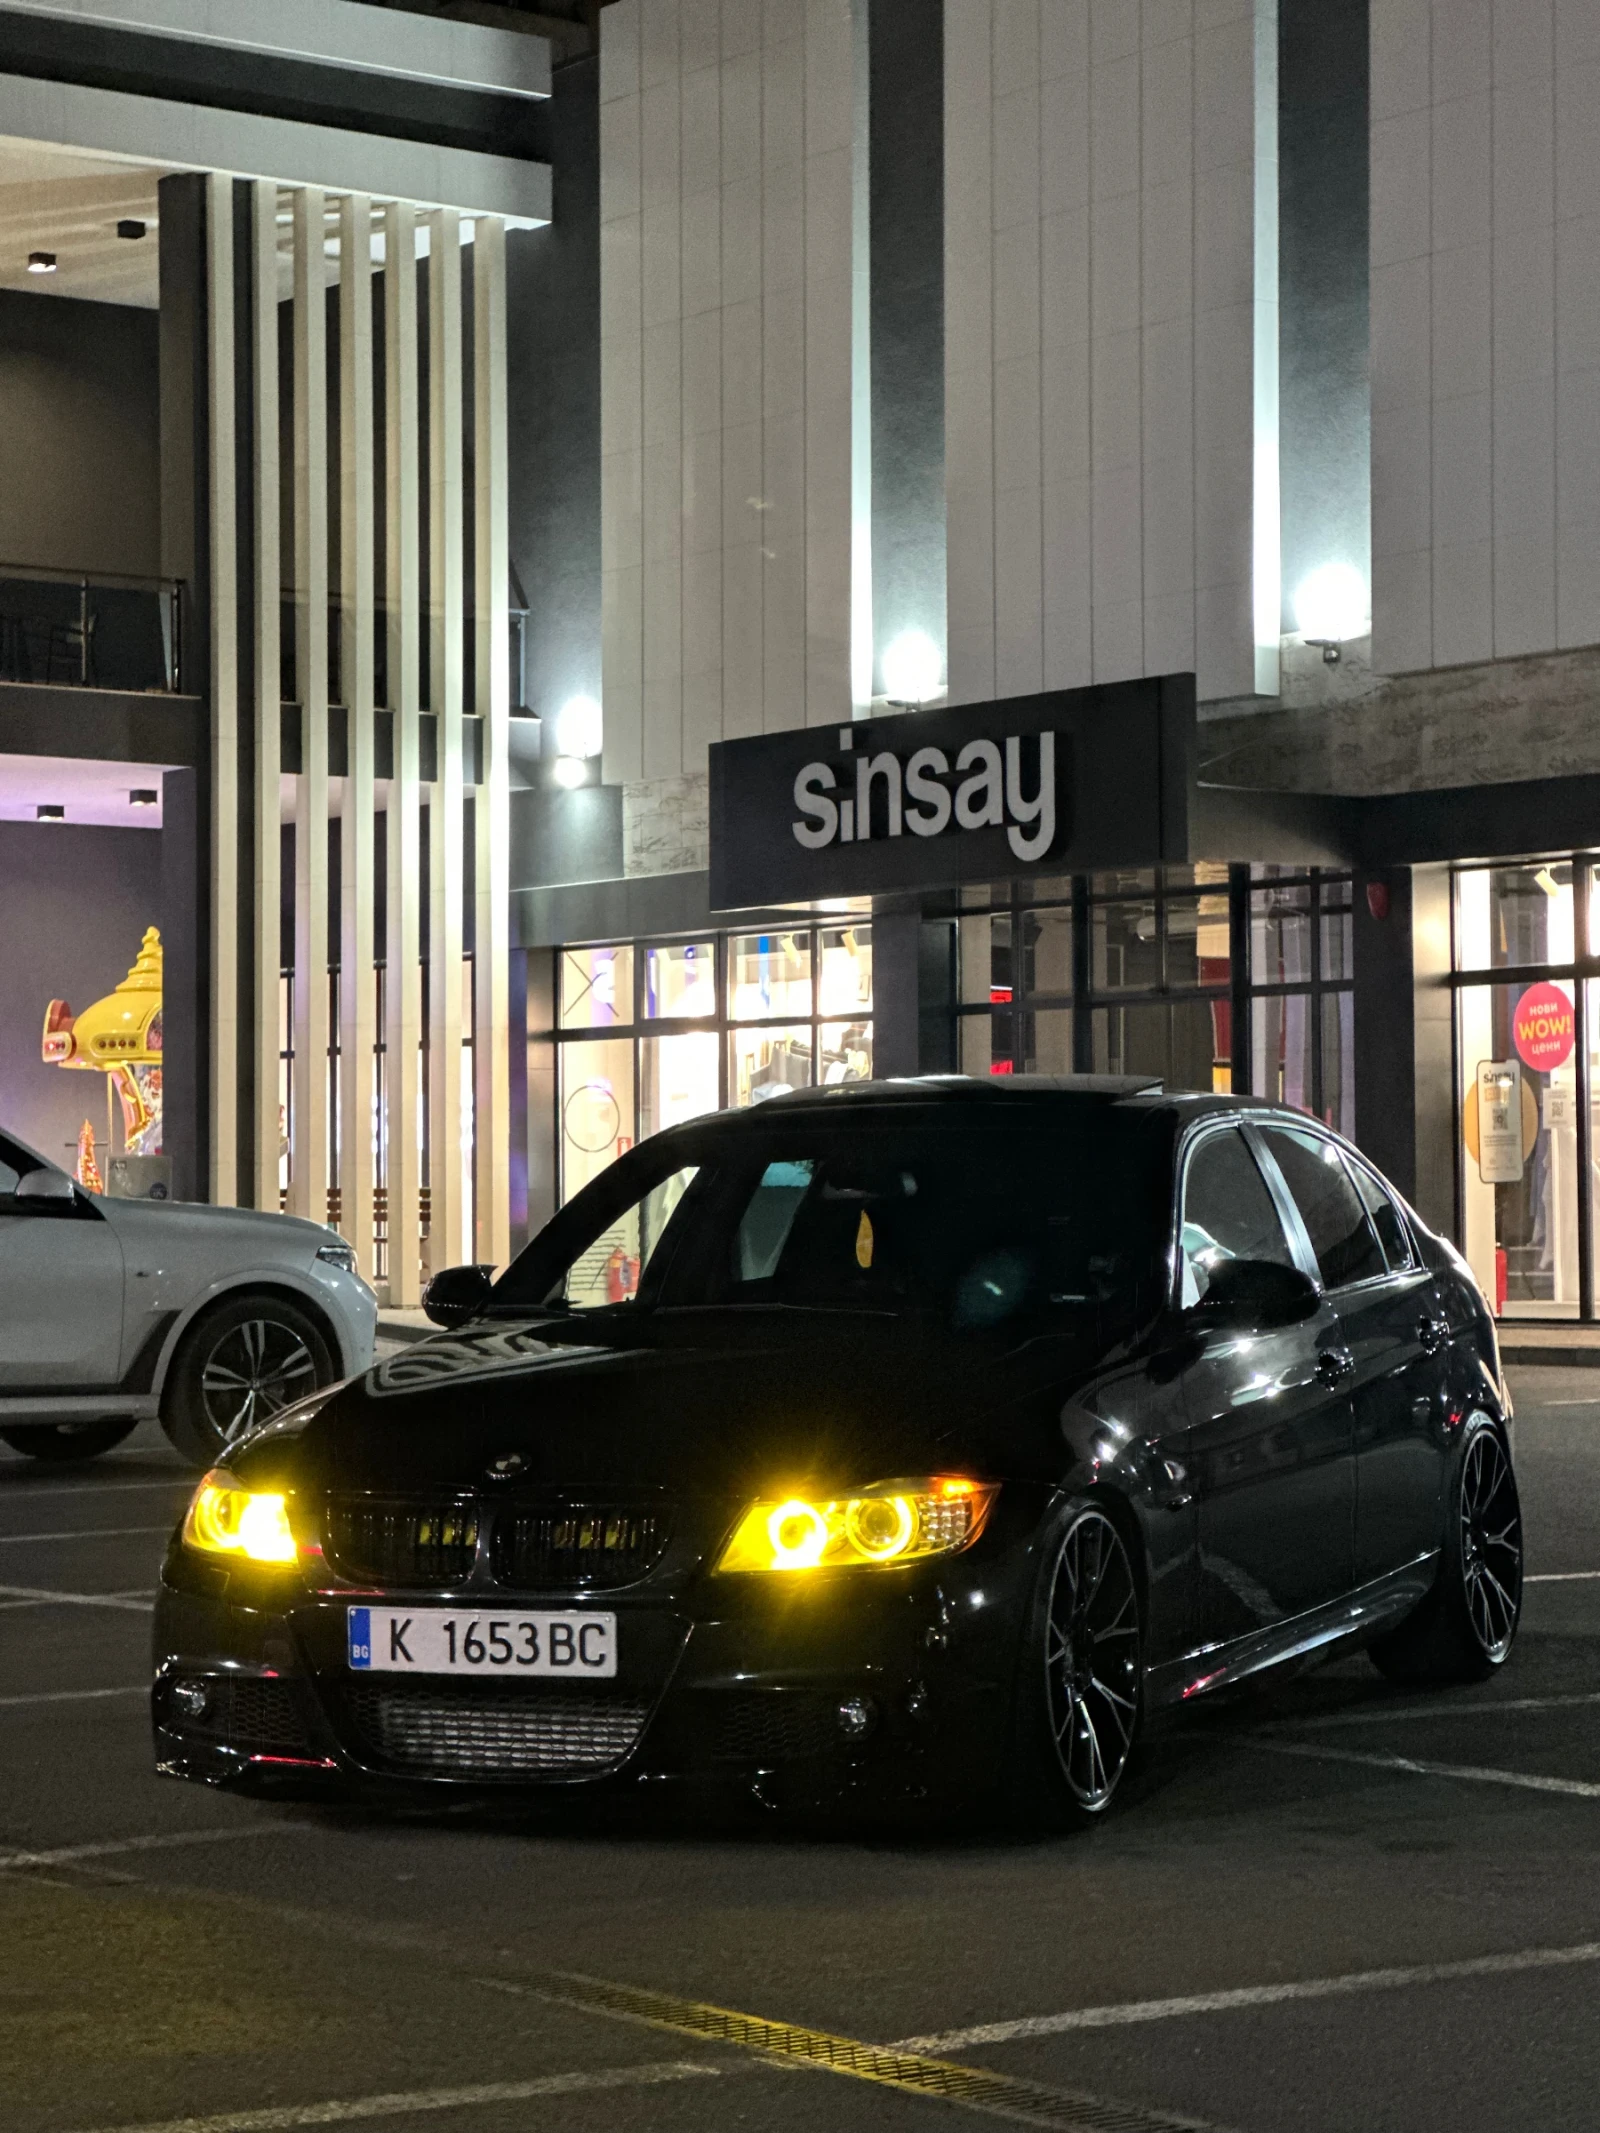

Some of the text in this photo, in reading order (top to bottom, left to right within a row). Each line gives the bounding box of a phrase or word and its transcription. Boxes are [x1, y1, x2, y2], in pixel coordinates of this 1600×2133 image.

[792, 728, 1056, 862] sinsay
[1518, 1014, 1572, 1041] WOW!
[1531, 1040, 1561, 1056] цени
[352, 1644, 369, 1659] BG
[390, 1618, 606, 1667] K 1653 BC
